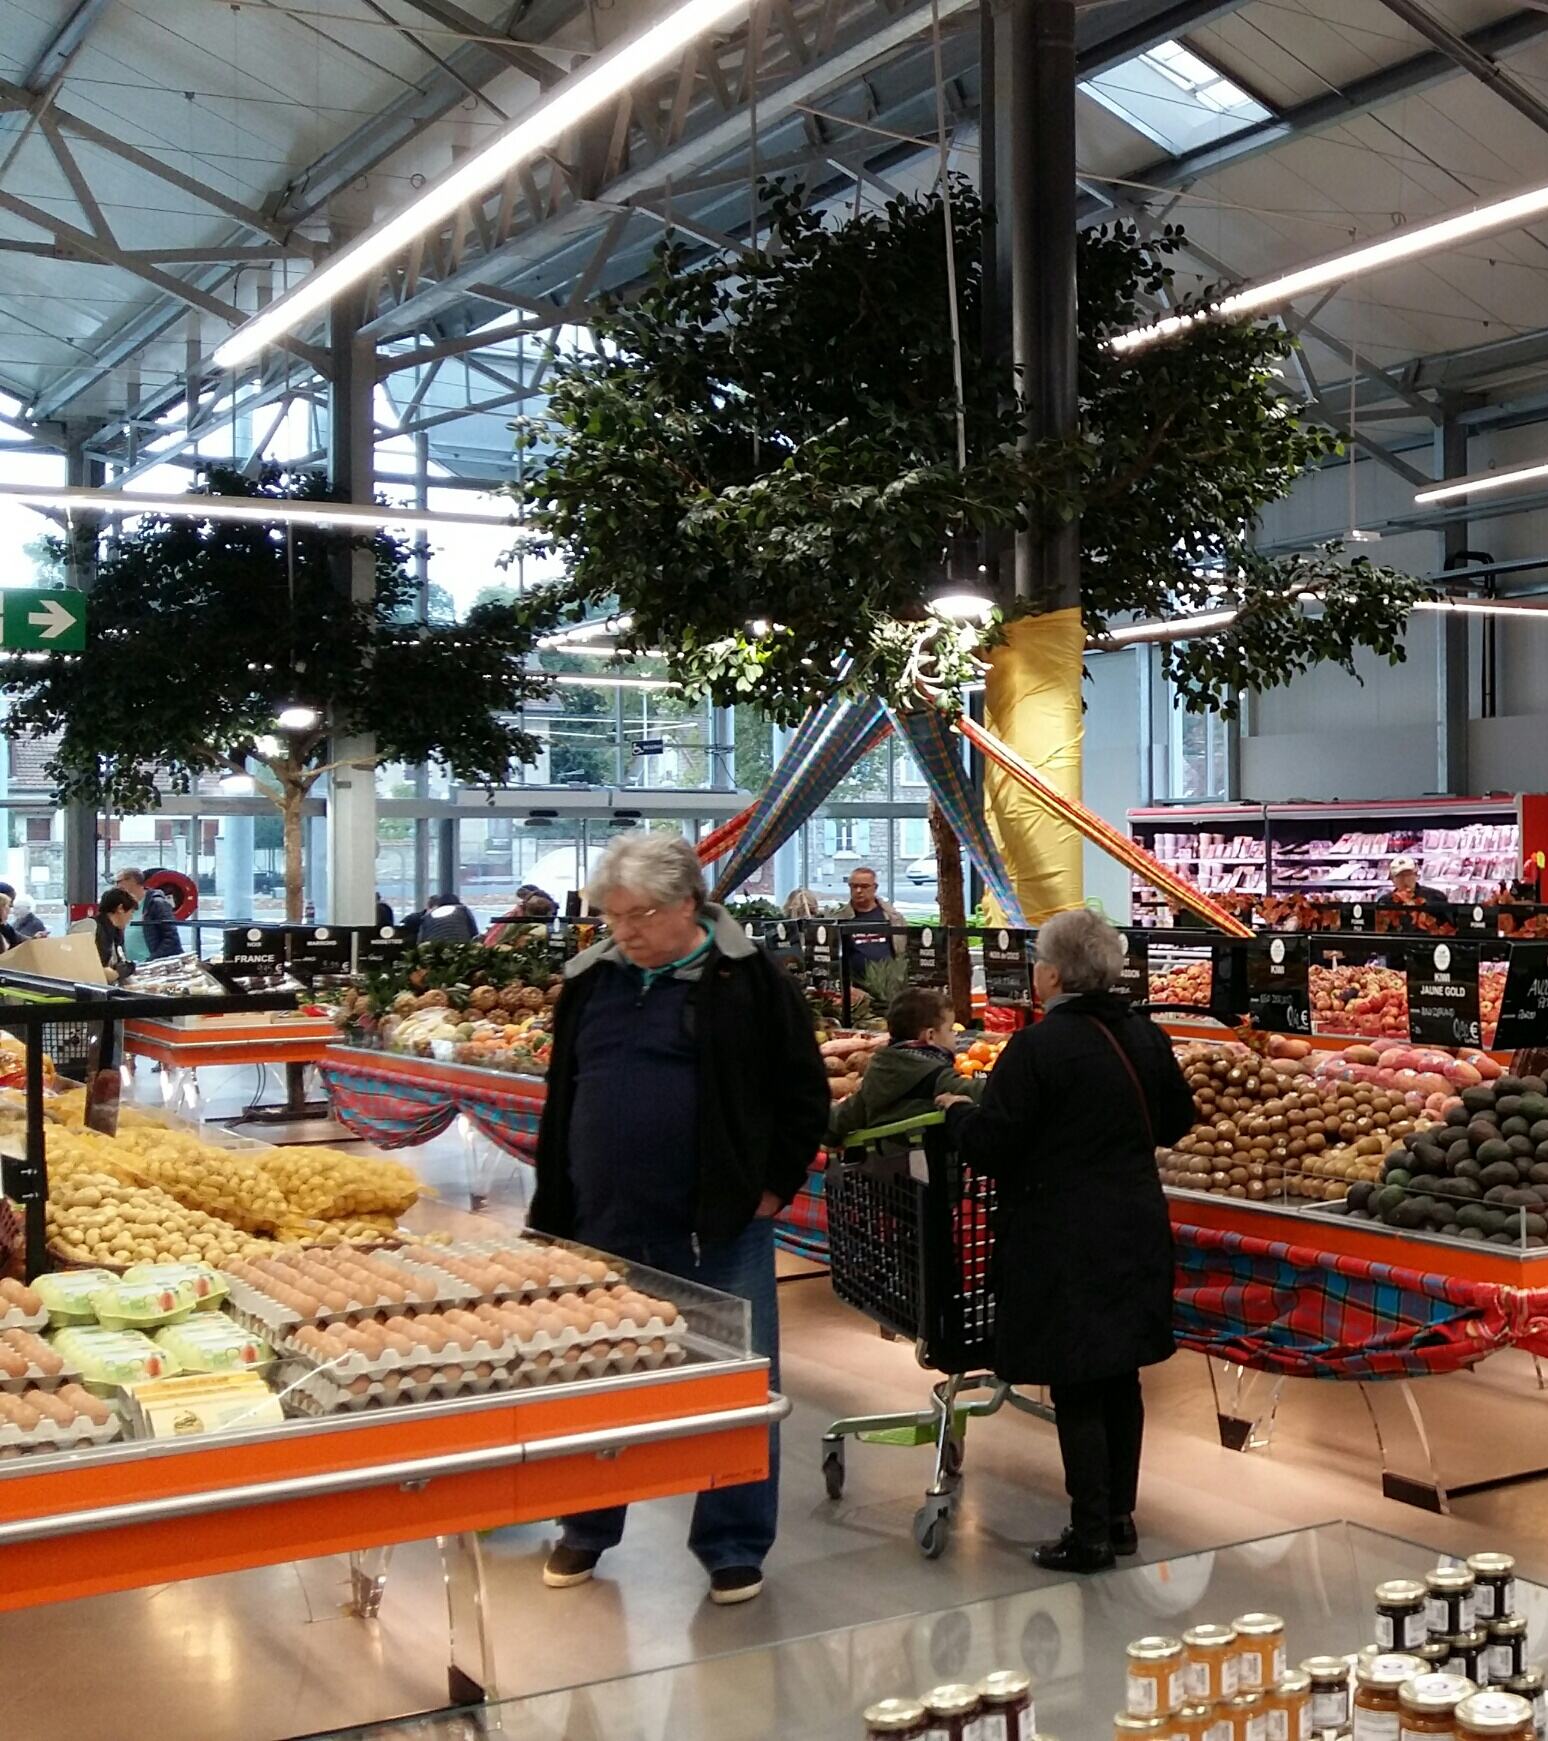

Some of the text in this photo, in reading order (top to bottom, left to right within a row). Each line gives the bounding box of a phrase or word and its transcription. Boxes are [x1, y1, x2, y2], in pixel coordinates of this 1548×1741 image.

[234, 954, 275, 963] FRANCE
[1420, 985, 1466, 998] JAUNE GOLD
